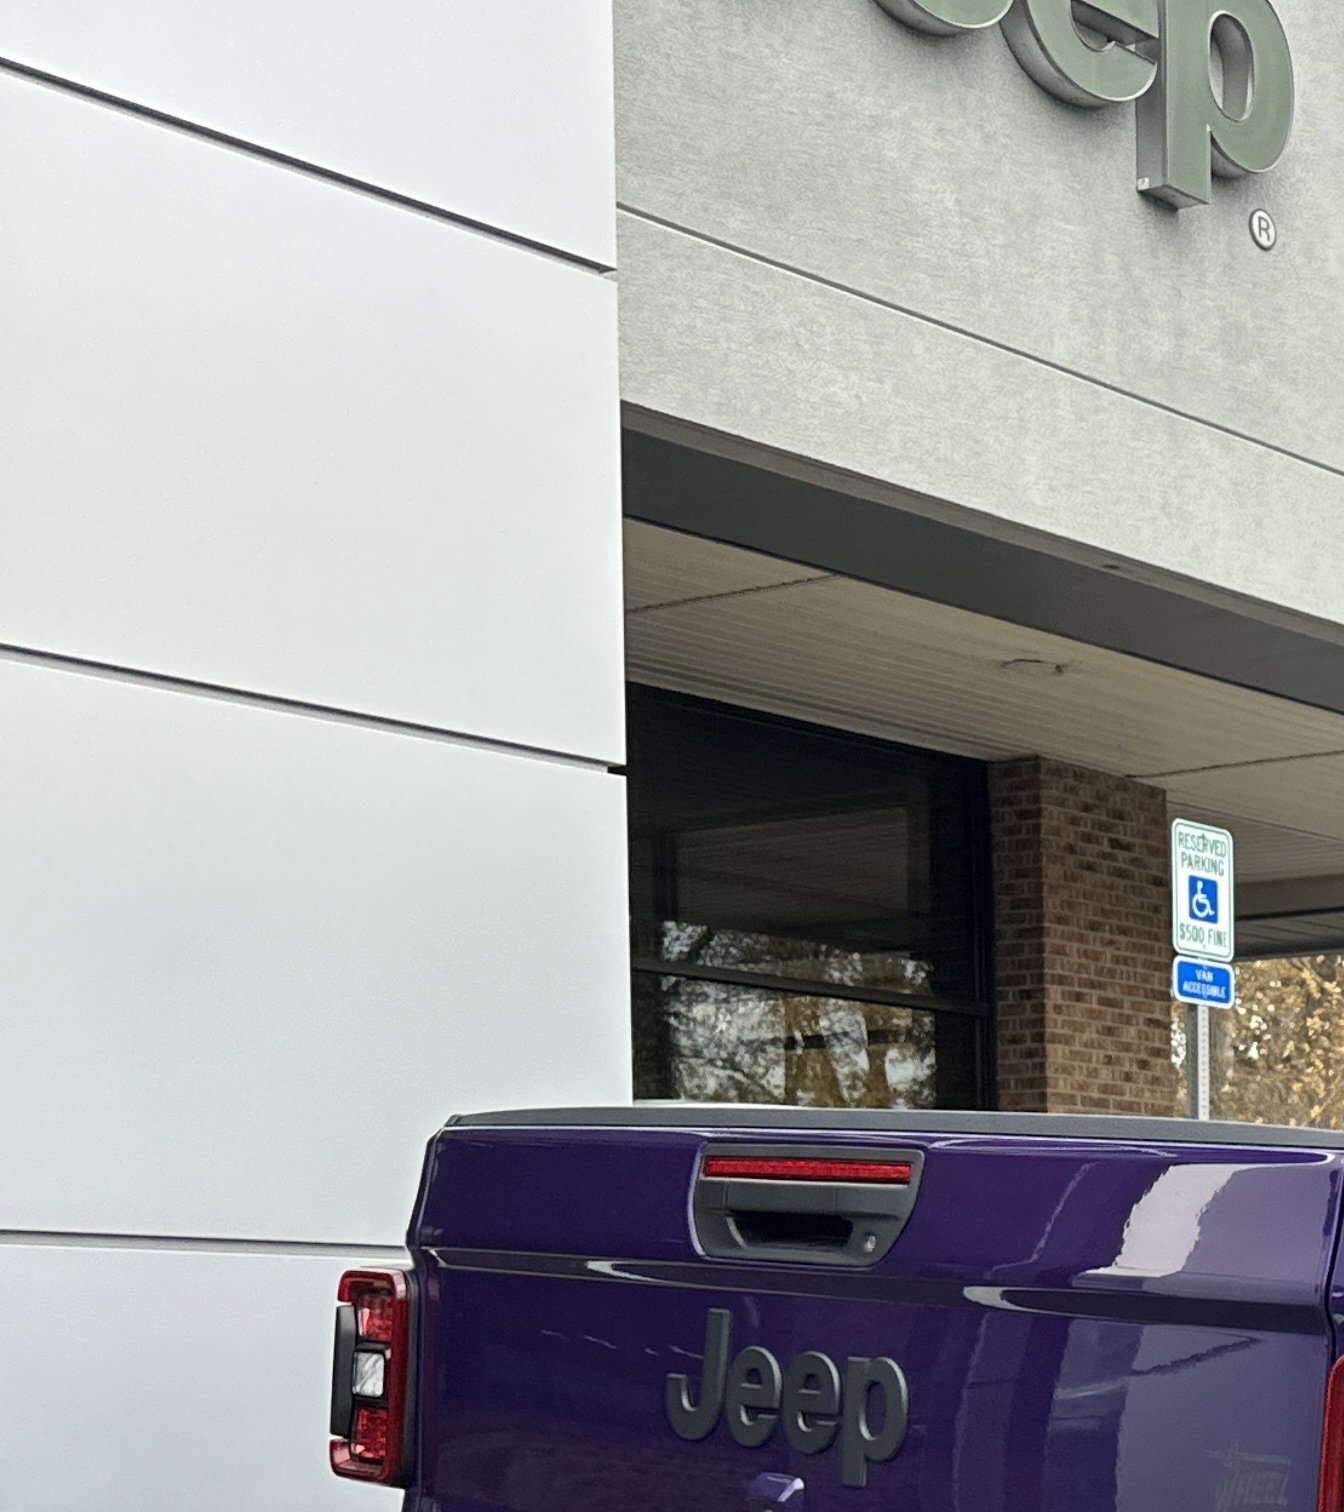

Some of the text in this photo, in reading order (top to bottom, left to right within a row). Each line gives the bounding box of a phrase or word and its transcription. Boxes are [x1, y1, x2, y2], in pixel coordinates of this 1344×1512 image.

[1178, 831, 1227, 858] RESERVED
[1180, 852, 1225, 876] PARKING
[1179, 923, 1228, 948] $500 FINE
[1195, 968, 1214, 983] VAN
[1182, 981, 1227, 999] ACCESSIBLE
[666, 1308, 909, 1487] Jeep
